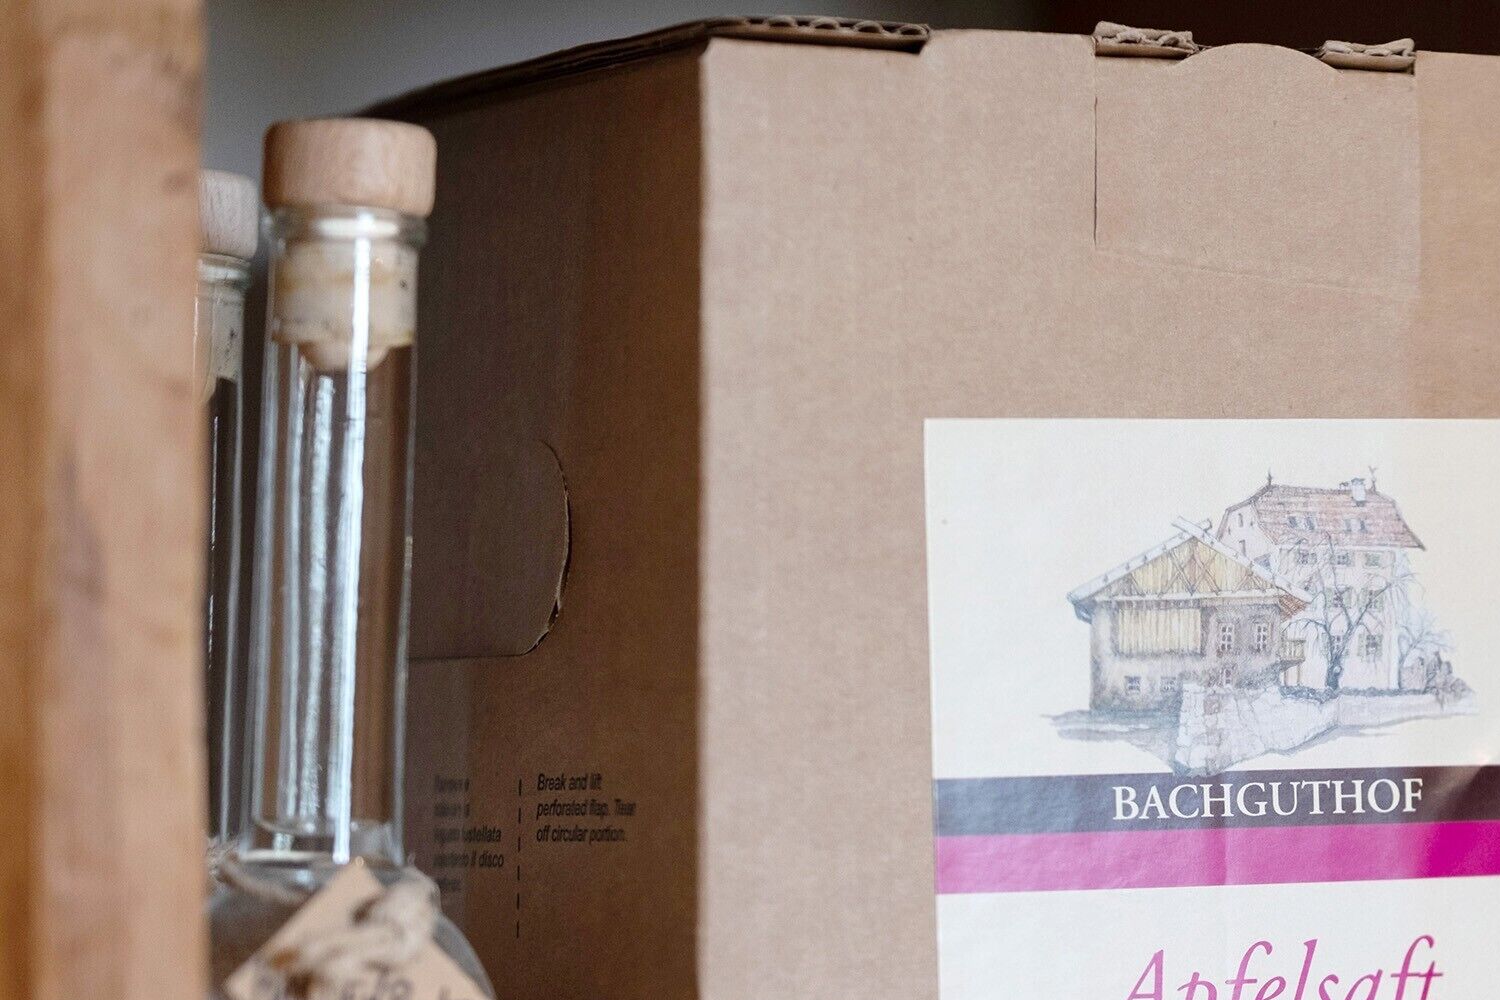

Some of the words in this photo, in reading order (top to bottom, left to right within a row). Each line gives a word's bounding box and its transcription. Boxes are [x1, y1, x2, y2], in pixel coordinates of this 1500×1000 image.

[537, 773, 566, 791] Break
[568, 773, 588, 791] and
[536, 798, 588, 820] perforated
[1112, 777, 1423, 823] BACHGUTHOF
[536, 824, 551, 842] off
[551, 825, 589, 842] circular
[479, 851, 504, 868] disco
